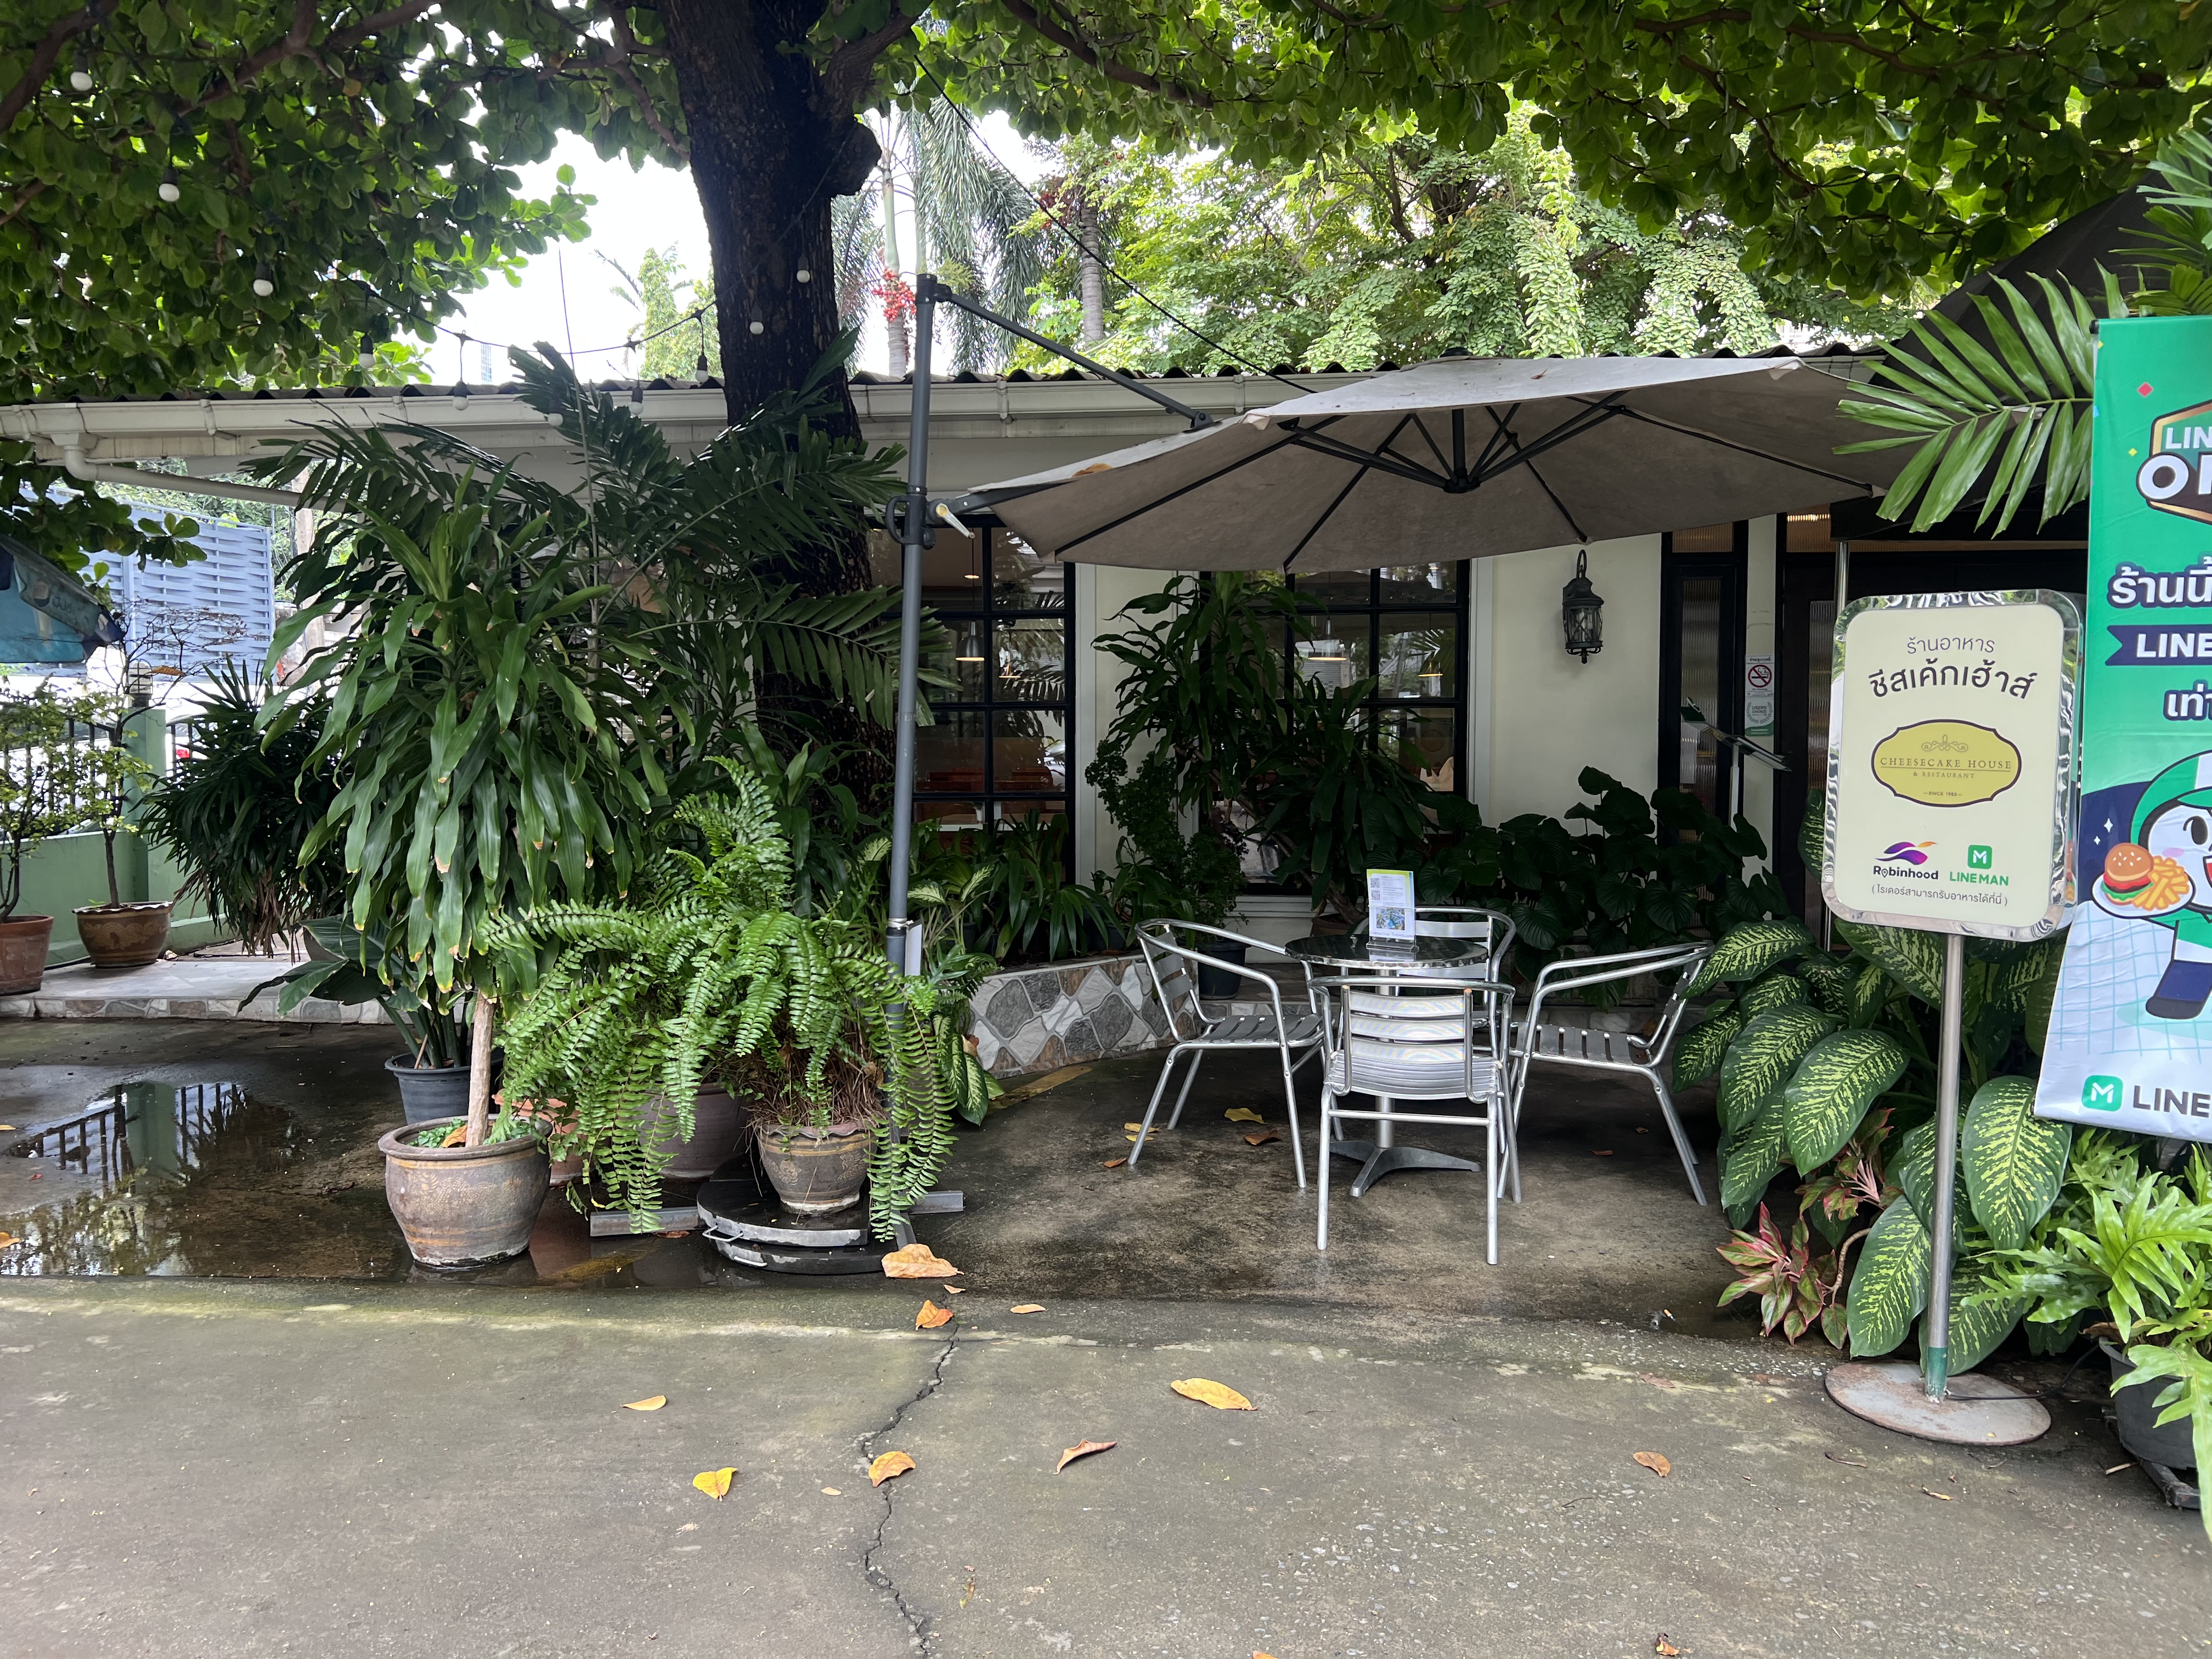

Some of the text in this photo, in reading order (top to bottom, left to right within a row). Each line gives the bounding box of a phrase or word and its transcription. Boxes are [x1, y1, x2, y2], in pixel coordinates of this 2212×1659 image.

[1907, 636, 1995, 654] ร้านอาหาร
[2136, 633, 2212, 658] LINE
[1868, 658, 2038, 699] ชีสเค้กเฮ้าส์
[1880, 758, 2011, 769] CHEESECAKE HOUSE
[1873, 865, 1939, 880] Robinhood
[2133, 1085, 2211, 1118] LINE
